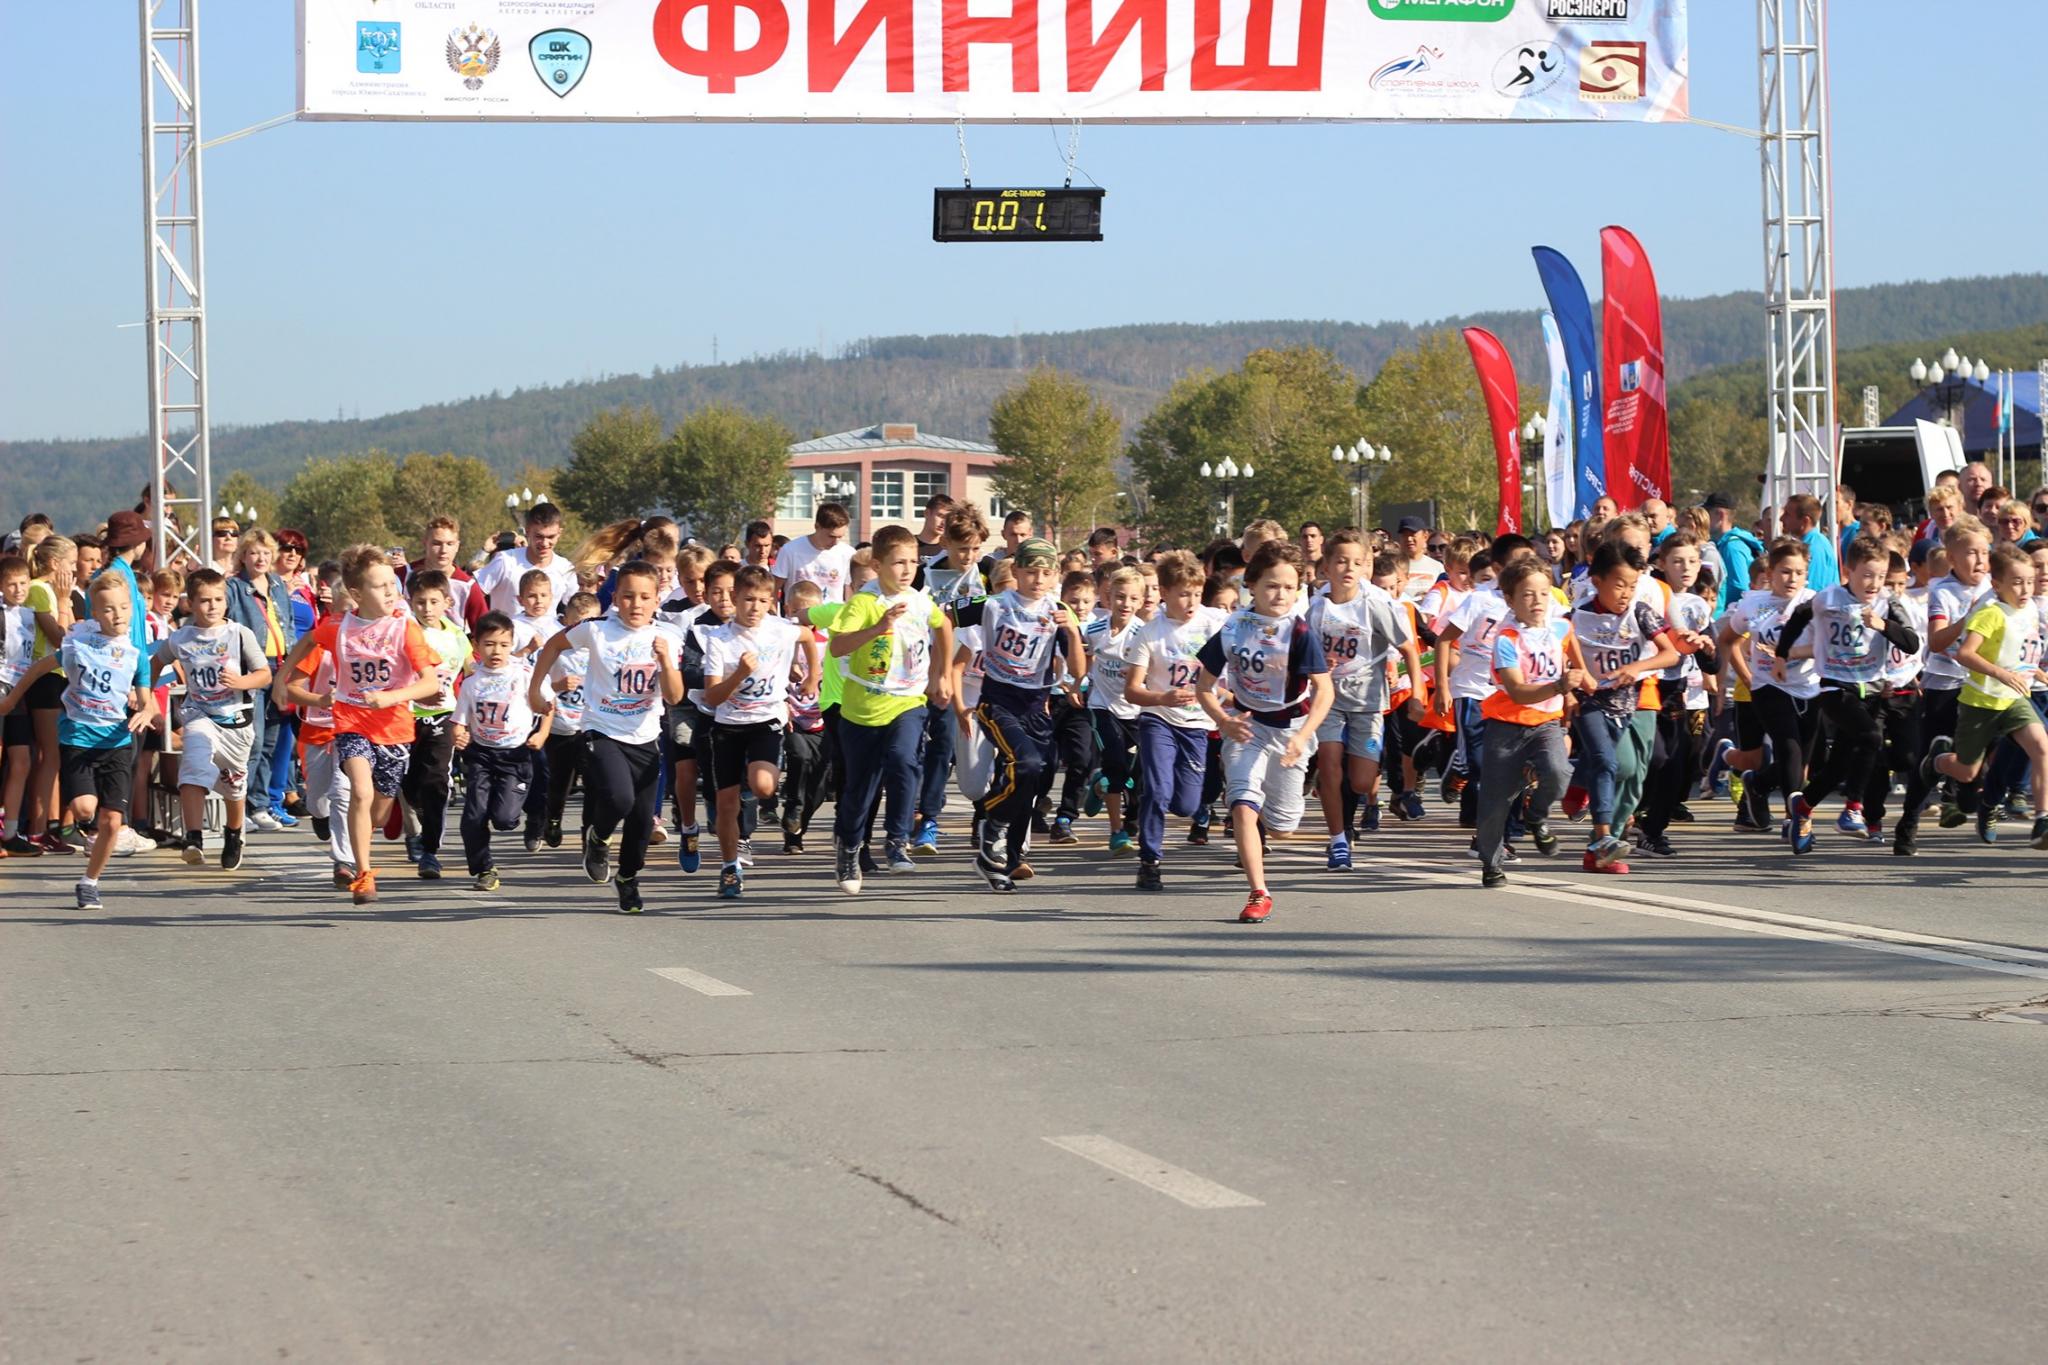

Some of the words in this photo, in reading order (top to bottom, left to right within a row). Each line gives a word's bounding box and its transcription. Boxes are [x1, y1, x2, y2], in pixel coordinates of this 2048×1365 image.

[653, 0, 1323, 94] ФИНИШ
[994, 624, 1040, 659] 1351
[1830, 621, 1864, 648] 262
[350, 659, 391, 683] 595
